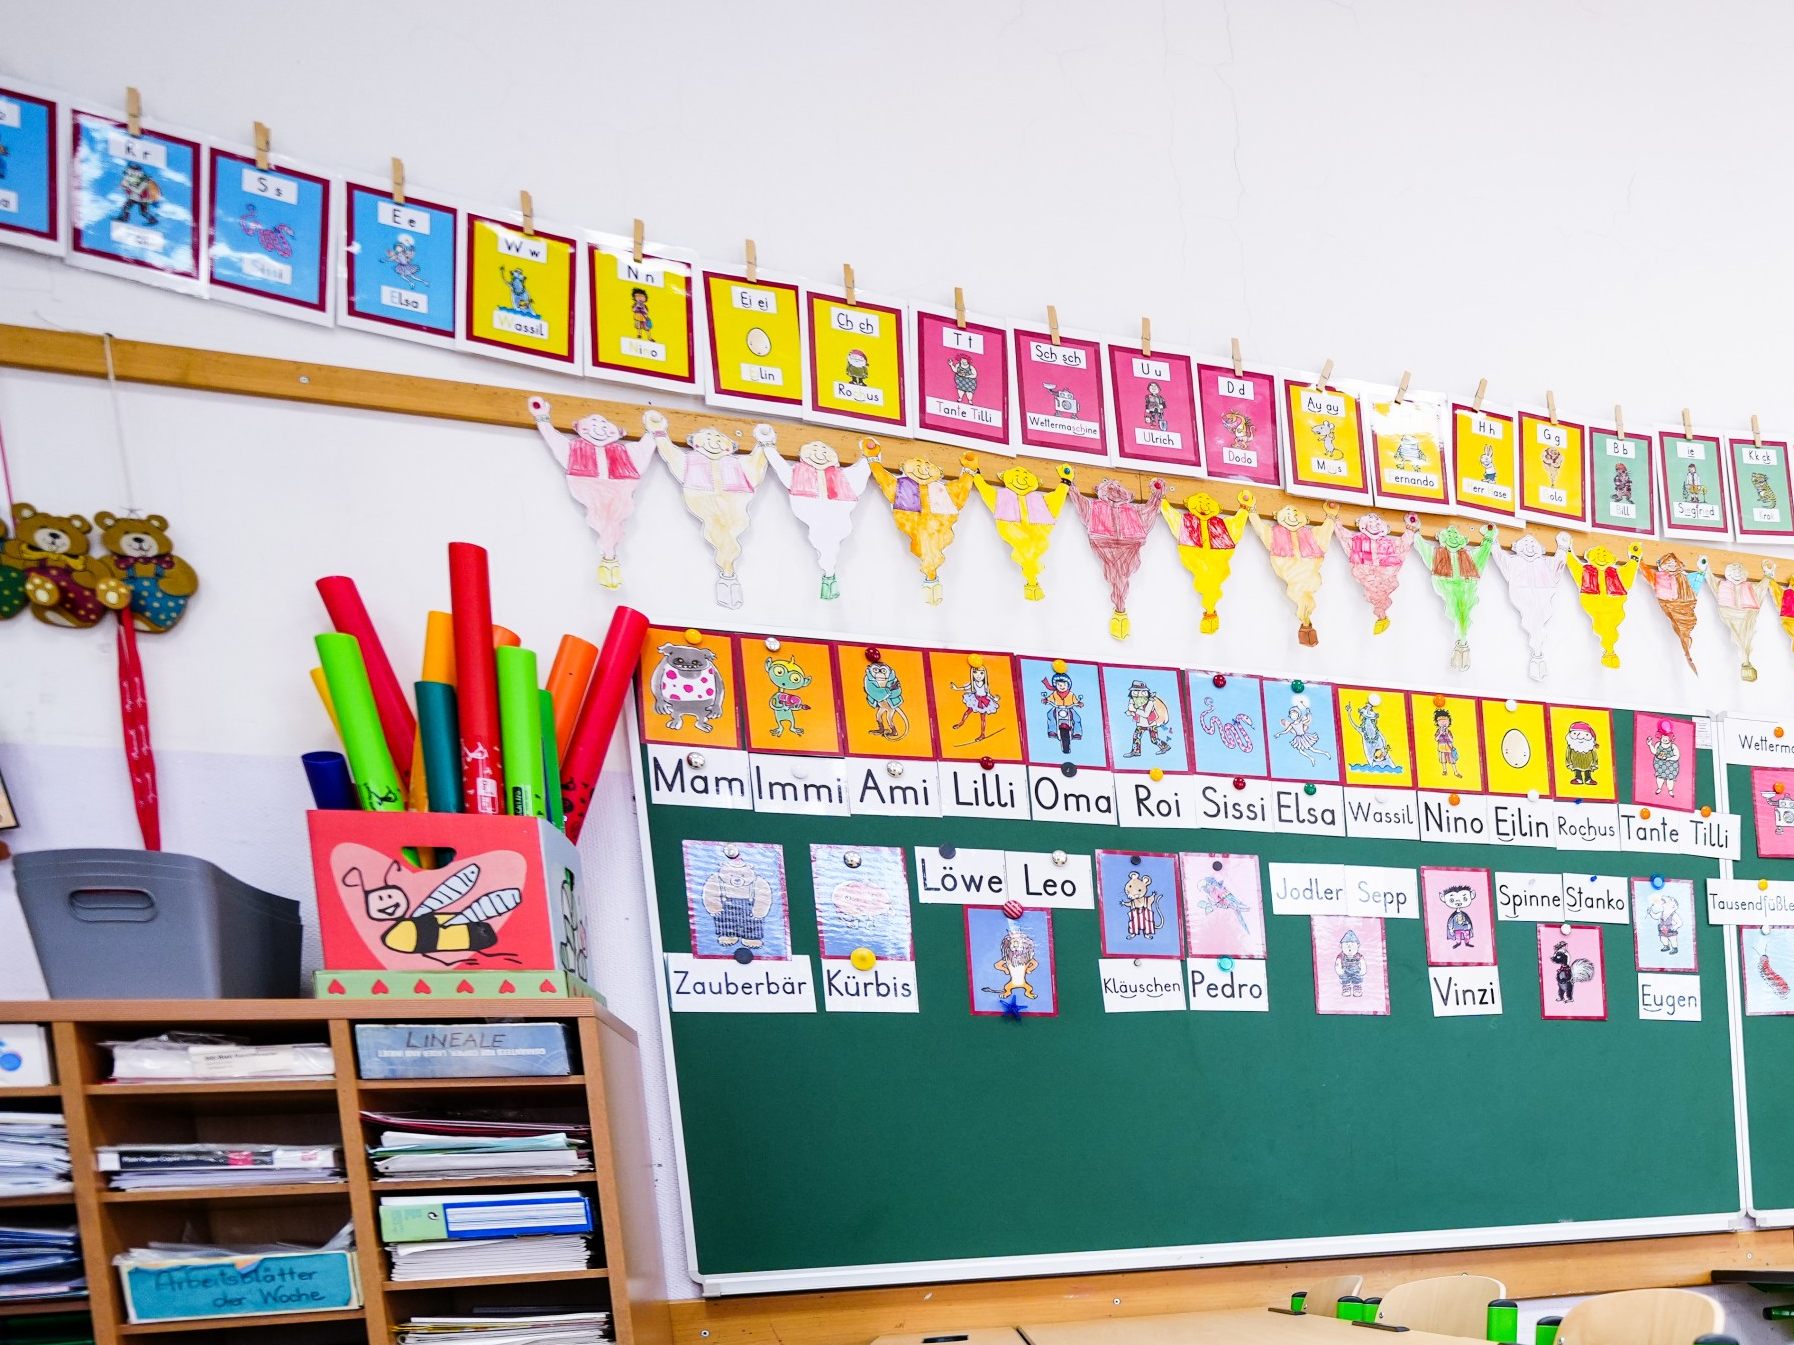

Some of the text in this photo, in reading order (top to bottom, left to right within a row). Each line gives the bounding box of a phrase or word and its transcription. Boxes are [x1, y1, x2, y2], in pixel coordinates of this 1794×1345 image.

[257, 177, 283, 197] S s
[392, 208, 416, 228] E e
[504, 238, 541, 258] W w
[627, 264, 654, 283] N n
[739, 291, 769, 309] Ei ei
[837, 313, 874, 332] Ch ch
[953, 332, 974, 349] T t
[1035, 345, 1082, 365] Sch sch
[1141, 363, 1163, 377] U u
[1227, 380, 1246, 396] D d
[936, 401, 993, 423] Tante Tilli
[1307, 396, 1340, 413] Au au
[1028, 415, 1098, 434] Wettermaschine
[1478, 421, 1496, 436] H h
[1143, 432, 1175, 446] Ulrich
[1543, 429, 1561, 446] G g
[1228, 450, 1253, 465] Dodo
[1613, 443, 1629, 456] B b
[1687, 446, 1696, 458] ie
[1748, 450, 1755, 461] K
[1762, 454, 1772, 464] ck
[1316, 460, 1343, 474] Ms
[1387, 471, 1435, 487] ernando
[653, 756, 745, 797] Mam
[755, 765, 843, 804] Immi
[859, 768, 929, 805] Ami
[953, 771, 1015, 808] Lilli
[1034, 776, 1112, 814] Oma
[1134, 784, 1181, 818] Roi
[1201, 785, 1266, 822] Sissi
[1276, 791, 1336, 826] Elsa
[1348, 801, 1414, 825] Wassil
[1424, 801, 1484, 835] Nino
[1495, 806, 1549, 839] Eilin
[1558, 816, 1615, 839] Rochus
[1621, 814, 1729, 849] Tante Tilli
[921, 858, 1077, 897] Löwe Leo
[1276, 877, 1407, 914] Jodler Sepp
[1499, 884, 1625, 915] Spinne Stanko
[673, 970, 807, 996] Zauberbär
[826, 969, 912, 998] Kürbis
[1103, 978, 1182, 995] Kläuschen
[1191, 970, 1263, 999] Pedro
[1433, 976, 1496, 1007] Vinzi
[1641, 984, 1698, 1015] Eugen
[406, 1031, 506, 1048] LINEALE
[154, 1267, 318, 1293] Arbeitsblätter
[212, 1284, 326, 1309] der Woche
